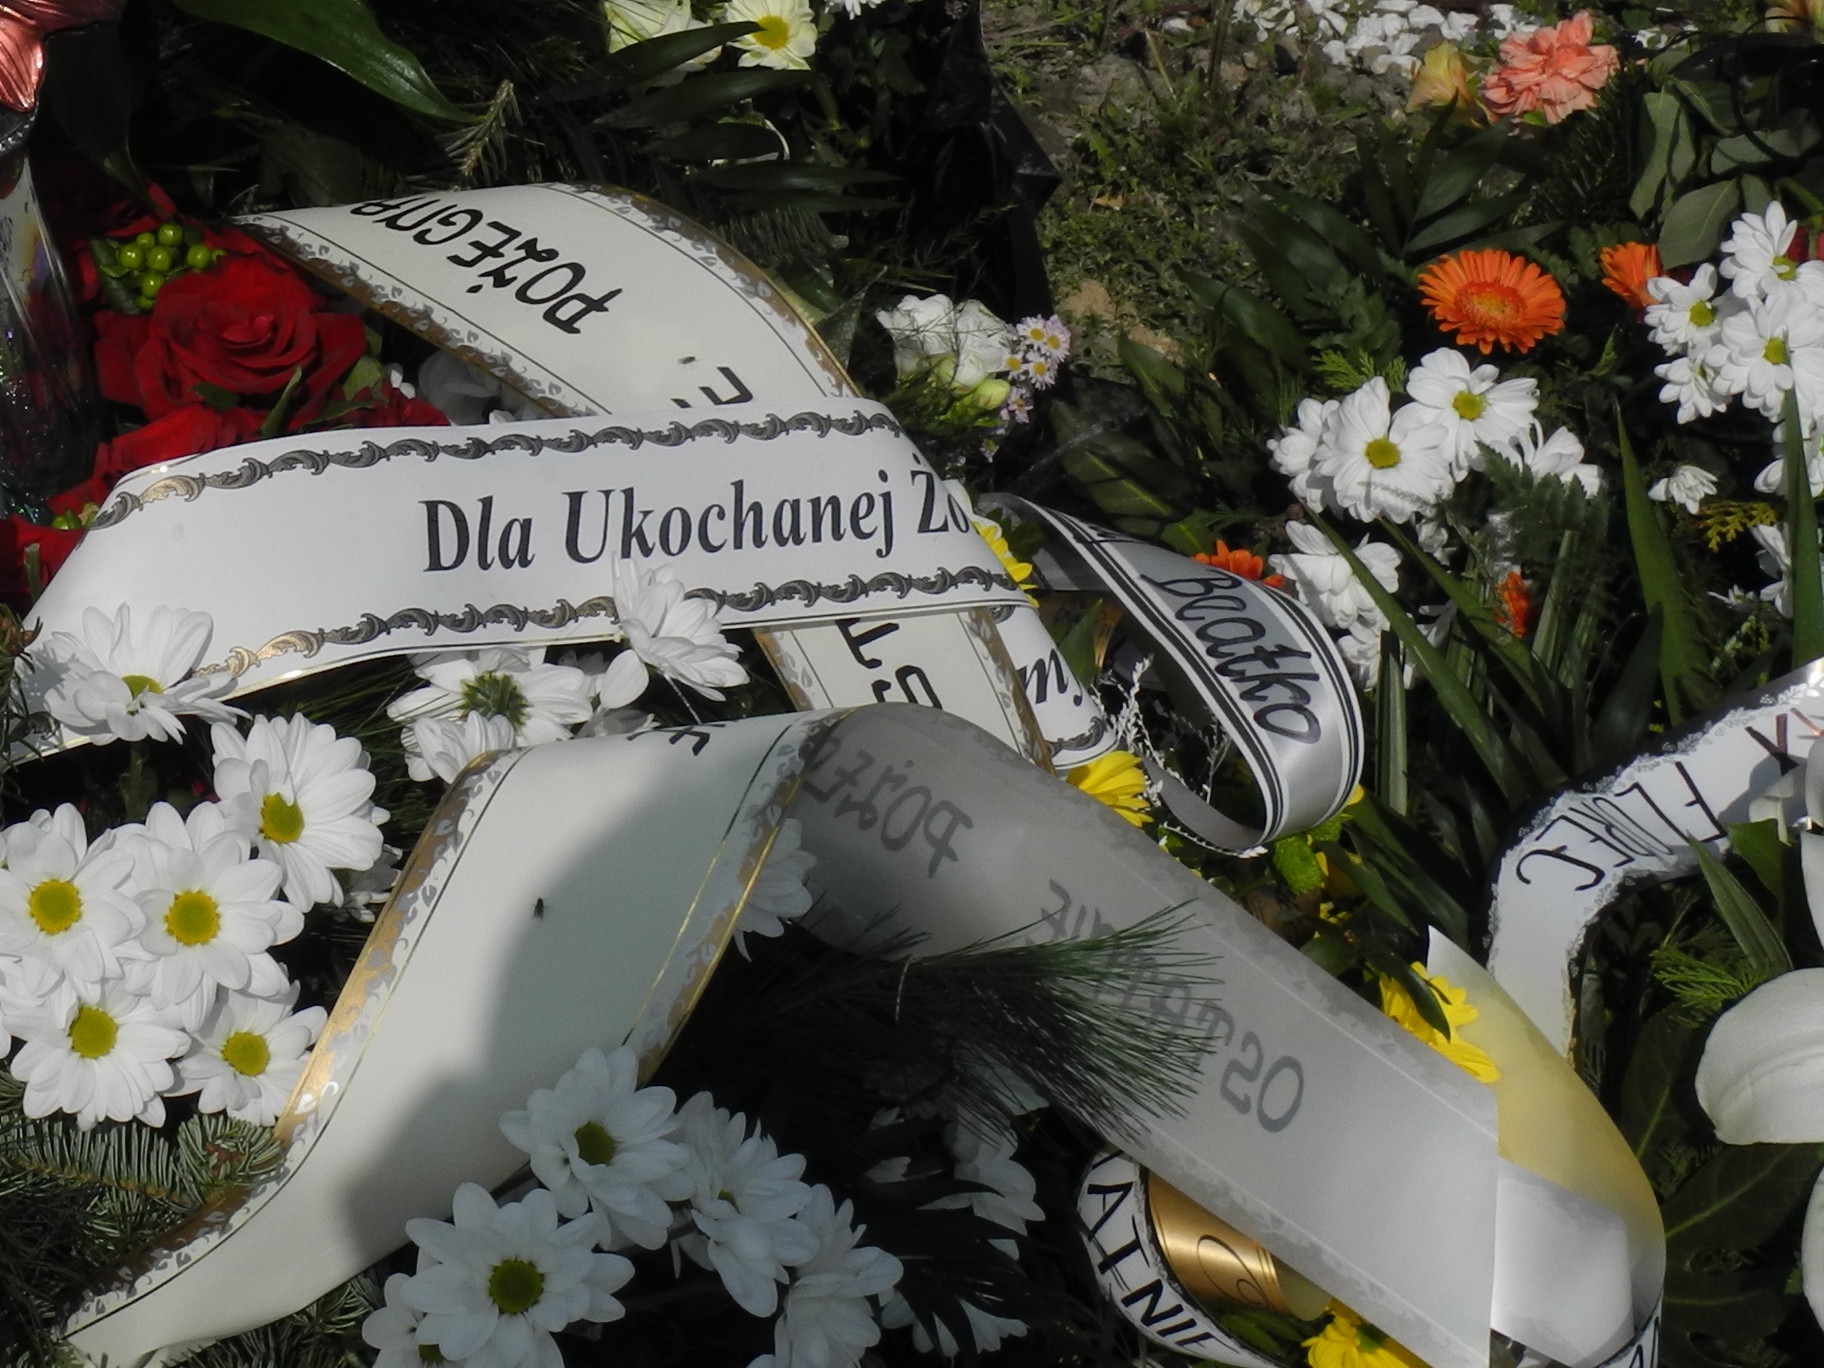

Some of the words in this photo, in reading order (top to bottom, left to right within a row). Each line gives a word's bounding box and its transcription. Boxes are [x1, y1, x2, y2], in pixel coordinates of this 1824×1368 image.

[418, 495, 536, 572] Dla
[561, 469, 895, 564] Ukochanej
[1138, 566, 1322, 745] Beatko
